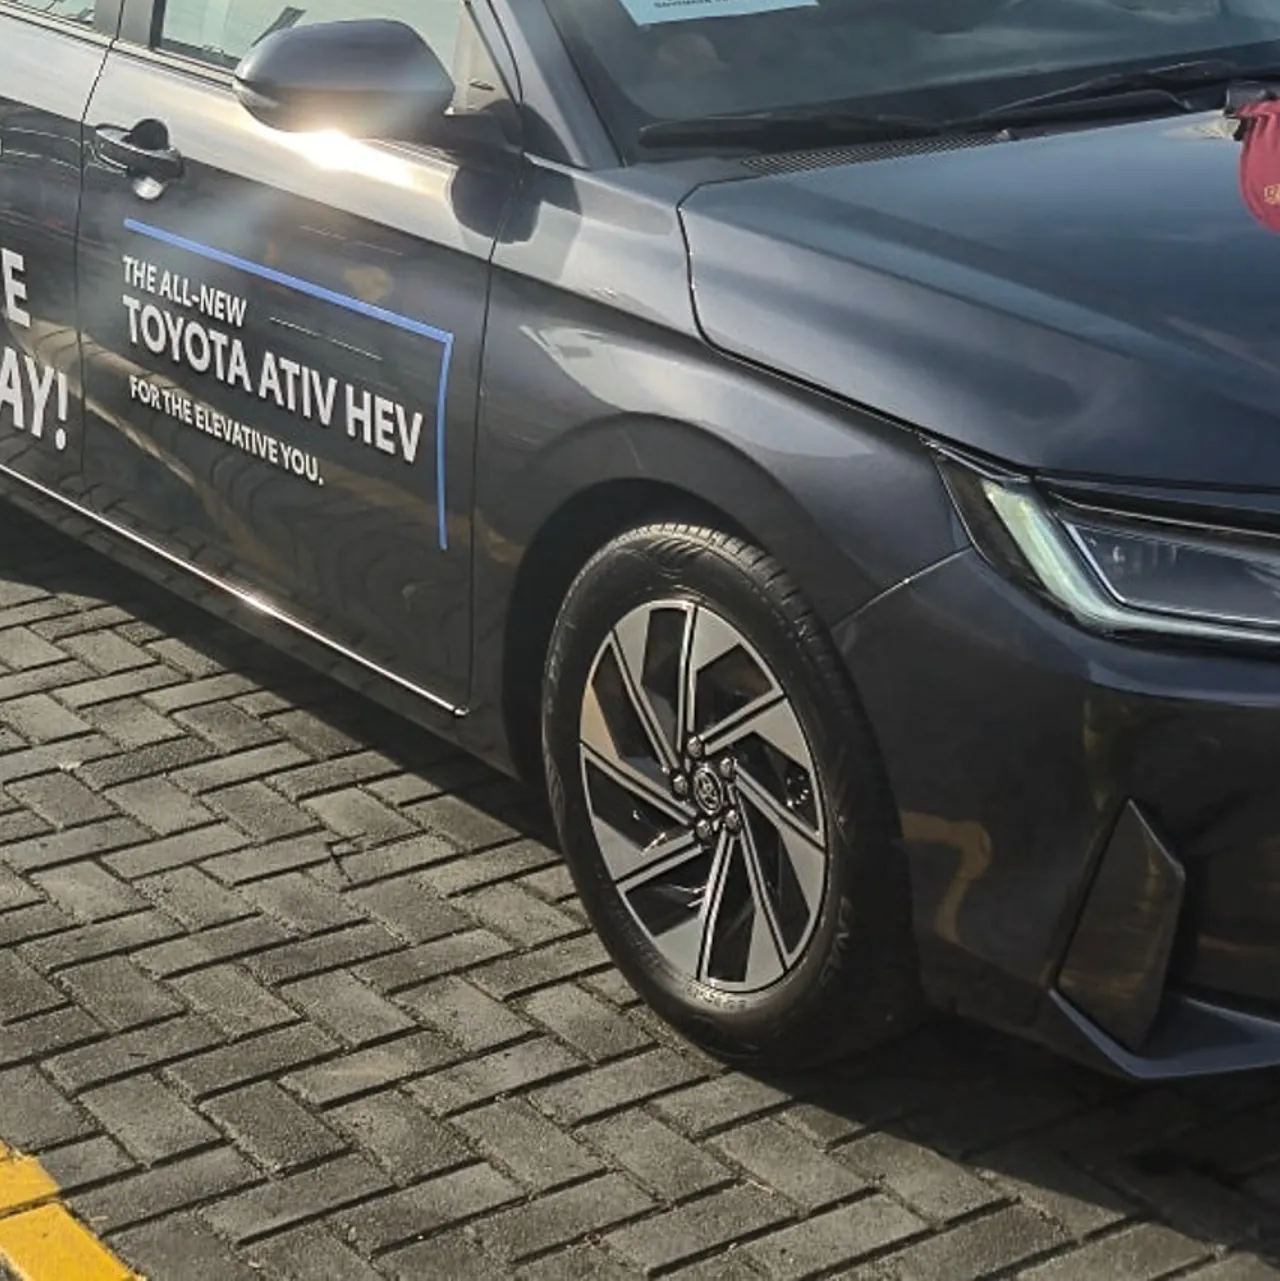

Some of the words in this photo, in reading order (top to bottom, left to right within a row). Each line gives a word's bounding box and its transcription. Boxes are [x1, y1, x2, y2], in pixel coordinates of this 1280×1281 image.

[123, 255, 156, 293] THE
[159, 271, 247, 328] ALL-NEW
[123, 295, 253, 393] TOYOTA
[258, 350, 338, 427] ATIV
[345, 383, 424, 464] HEV
[130, 375, 161, 410] FOR
[161, 391, 193, 425] THE
[194, 404, 280, 464] ELEVATIVE
[279, 442, 324, 486] YOU.
